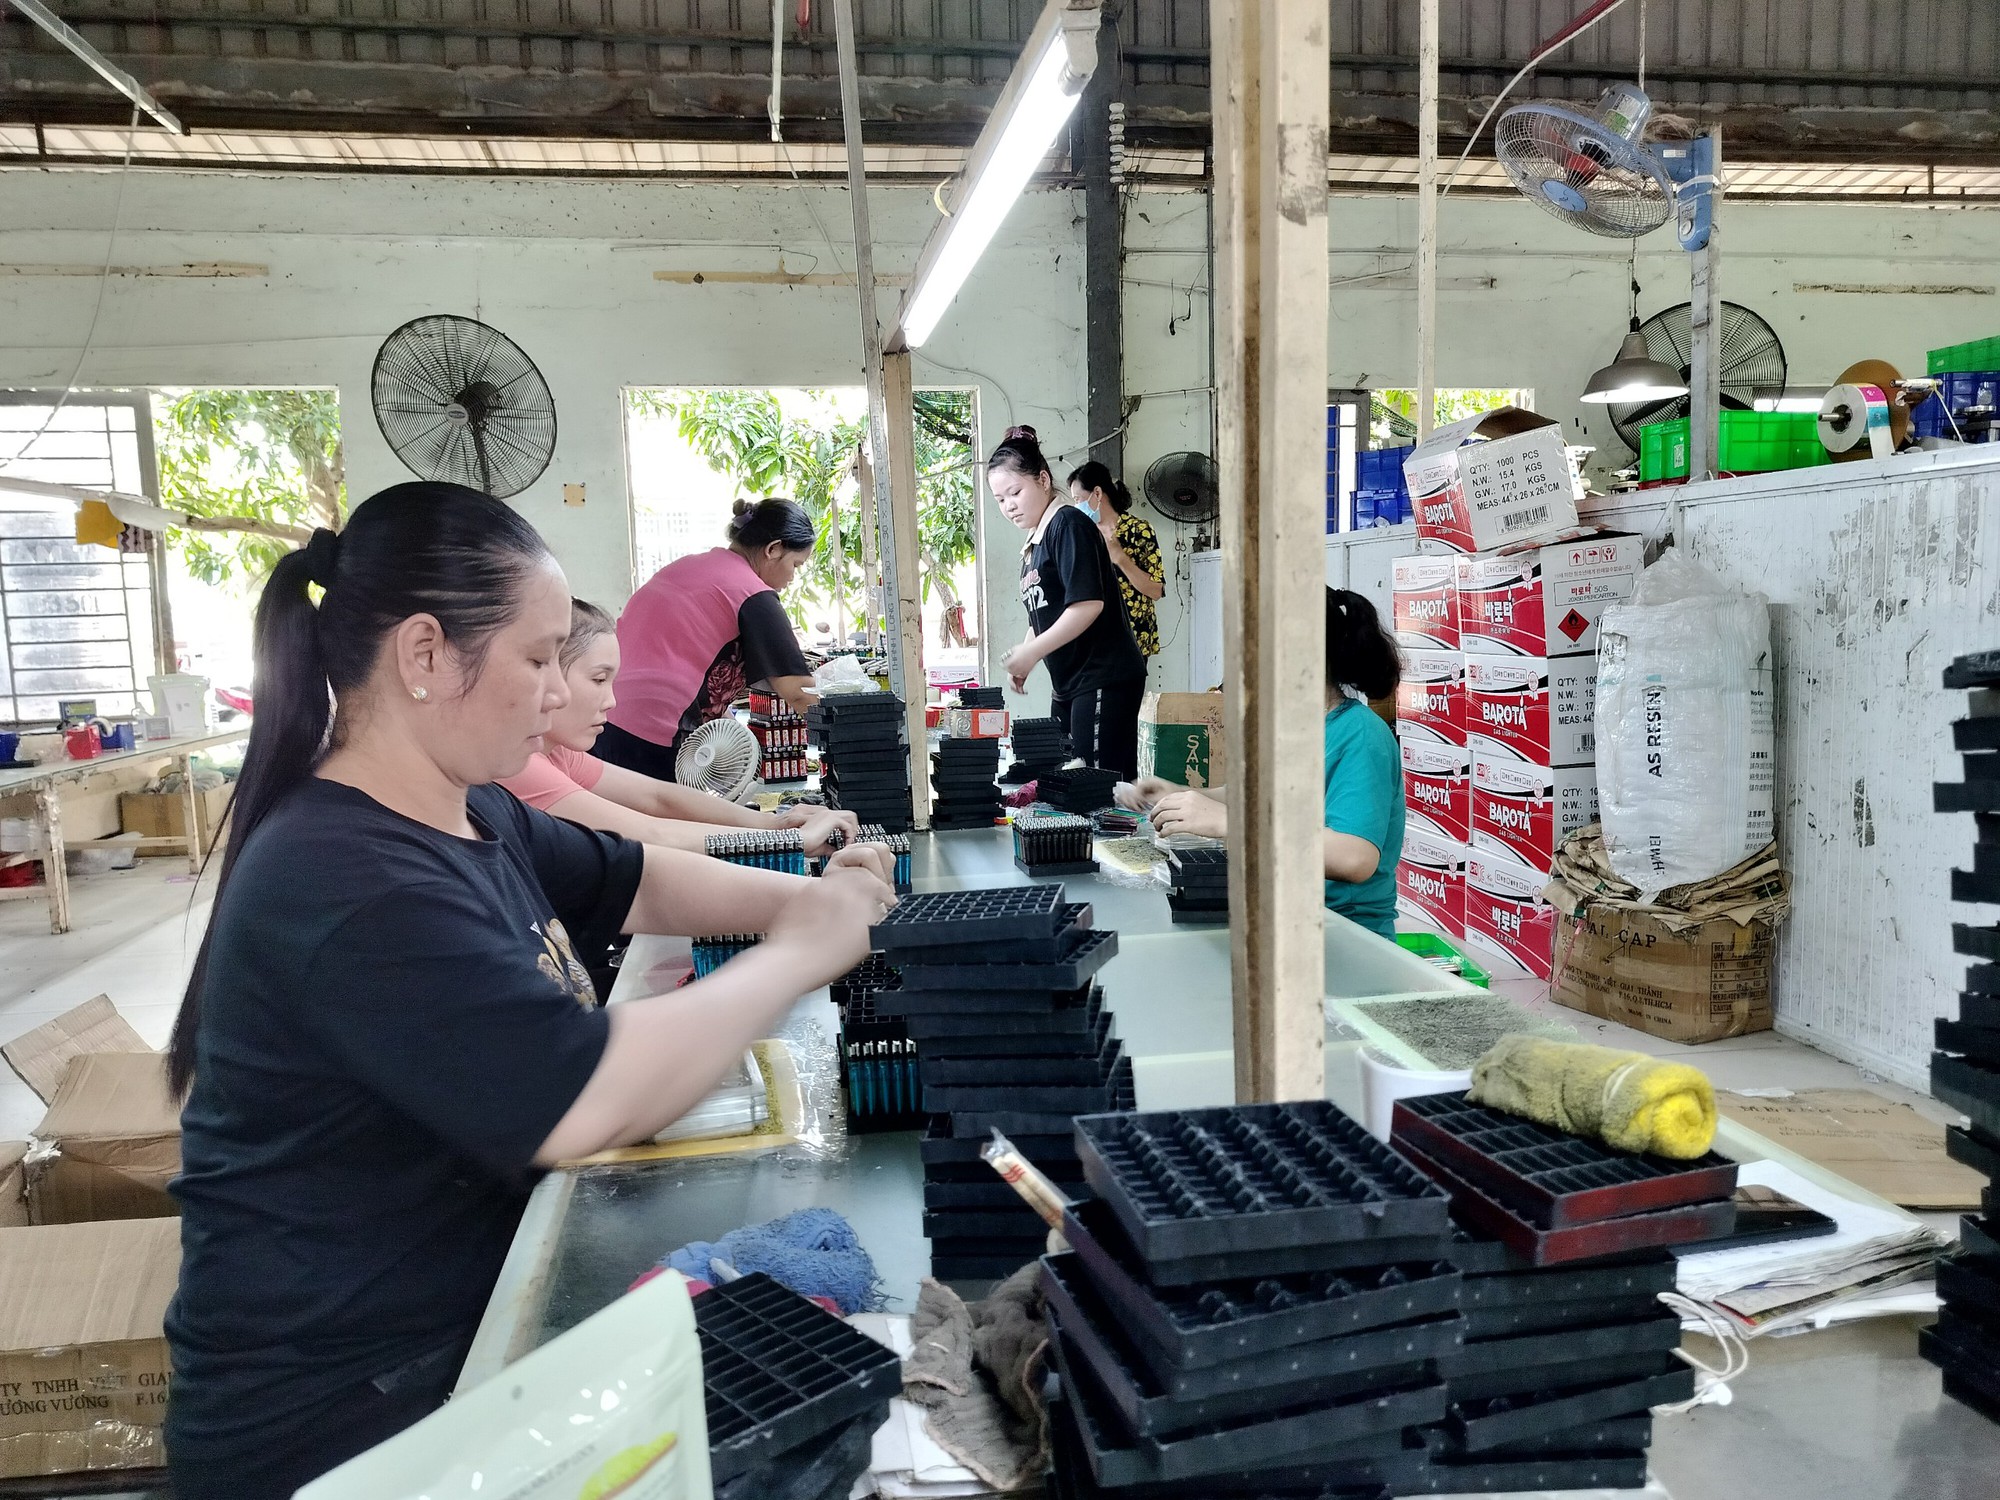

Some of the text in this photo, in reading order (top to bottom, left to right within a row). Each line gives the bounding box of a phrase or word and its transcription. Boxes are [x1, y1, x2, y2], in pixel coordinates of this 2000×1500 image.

[1469, 449, 1539, 475] Q'TY: 1000 PCS
[1499, 469, 1514, 480] 15.4
[1524, 461, 1543, 473] KGS
[1501, 481, 1517, 492] 17.0
[1527, 473, 1546, 485] KGS
[1477, 498, 1501, 511] MEAS:
[1520, 490, 1529, 500] 26
[1424, 502, 1457, 525] BAROTA
[882, 525, 889, 539] 30
[885, 560, 892, 575] 30
[888, 602, 896, 631] LONG
[1409, 600, 1449, 620] BAROTA
[1484, 601, 1513, 624] 바로타
[1557, 678, 1578, 687] Q'TY:
[1411, 692, 1450, 716] BAROTA
[1482, 701, 1527, 731] BAROTA
[1558, 715, 1582, 725] MEAS:
[1647, 691, 1662, 777] AS RESIN
[1414, 781, 1451, 810] BAROTA
[1562, 789, 1583, 797] Q'TY:
[1489, 801, 1532, 836] BAROTA
[1408, 870, 1447, 904] BAROTA
[1492, 906, 1520, 937] 바로타
[1619, 929, 1657, 948] CAP
[0, 1382, 21, 1396] TY
[32, 1378, 79, 1394] TNHH
[50, 1394, 109, 1412] VƯƠNG
